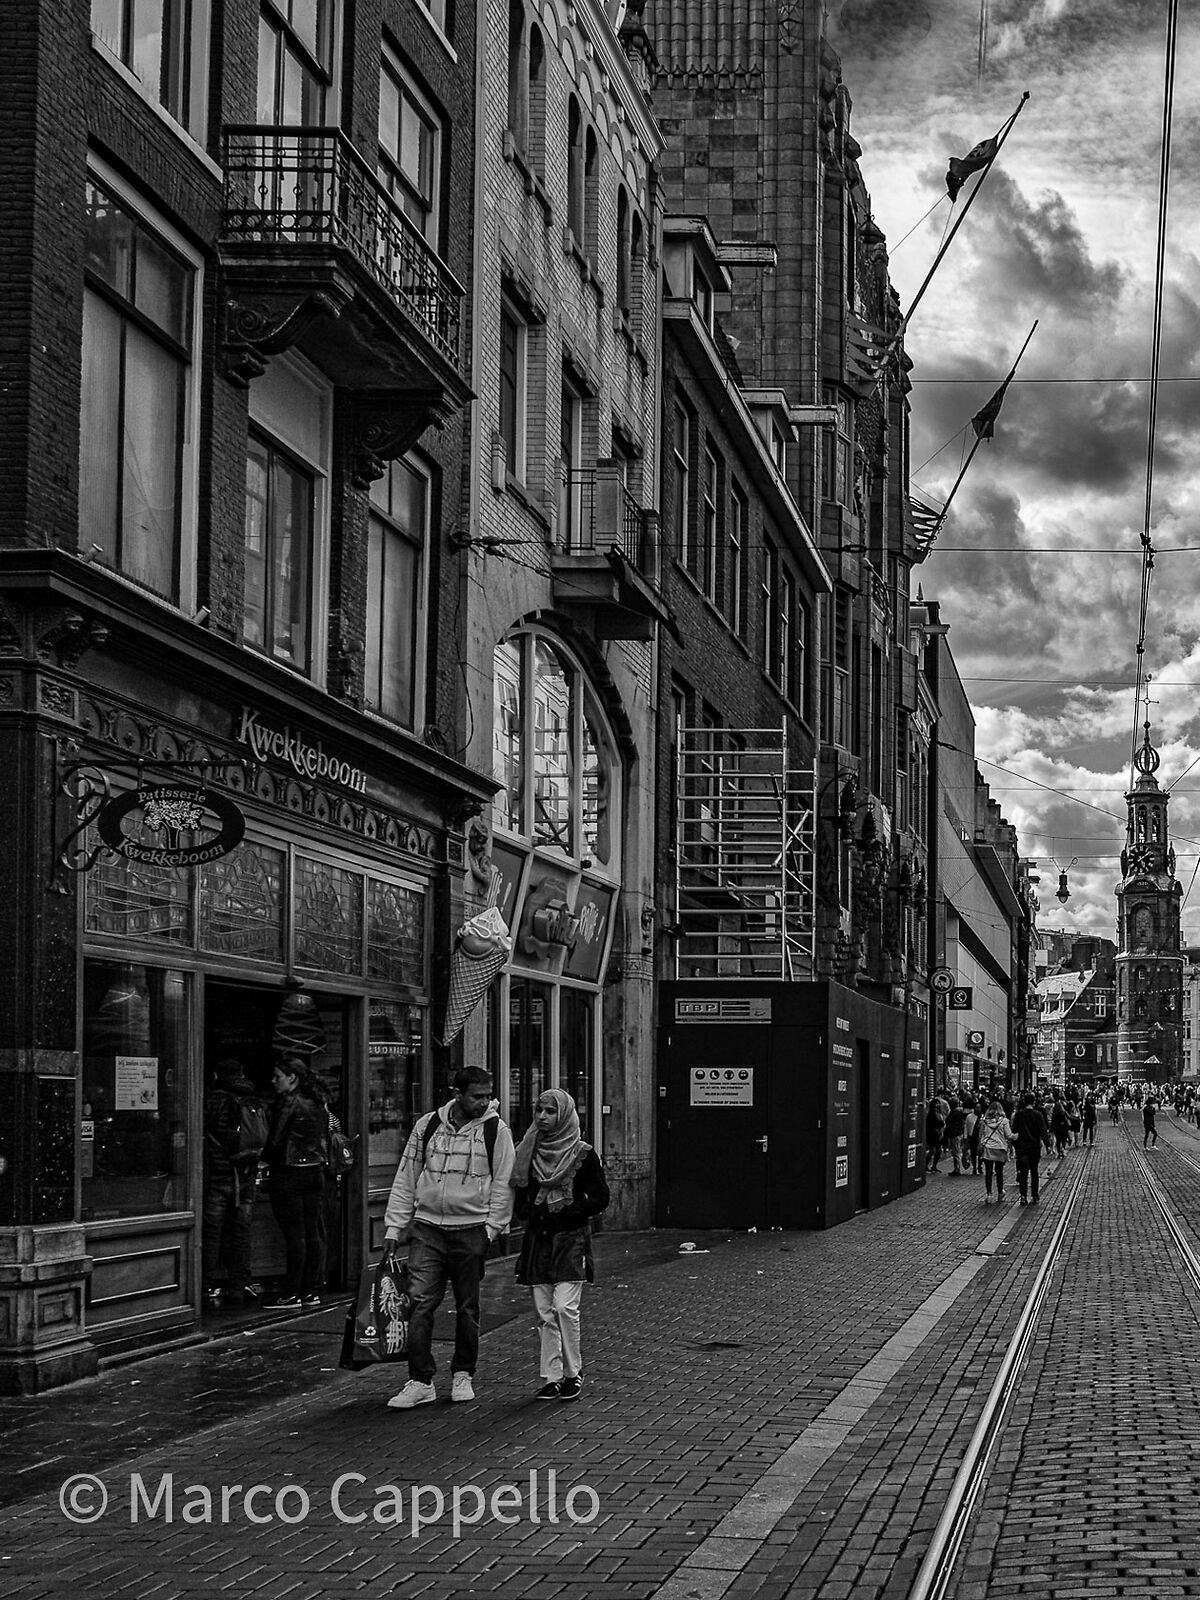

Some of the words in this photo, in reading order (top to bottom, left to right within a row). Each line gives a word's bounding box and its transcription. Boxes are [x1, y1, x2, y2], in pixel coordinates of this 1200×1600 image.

[237, 705, 367, 794] Kwekkeboom
[137, 788, 207, 803] Patisserie
[116, 838, 226, 867] Kwekkeboom
[680, 1003, 716, 1012] TBP
